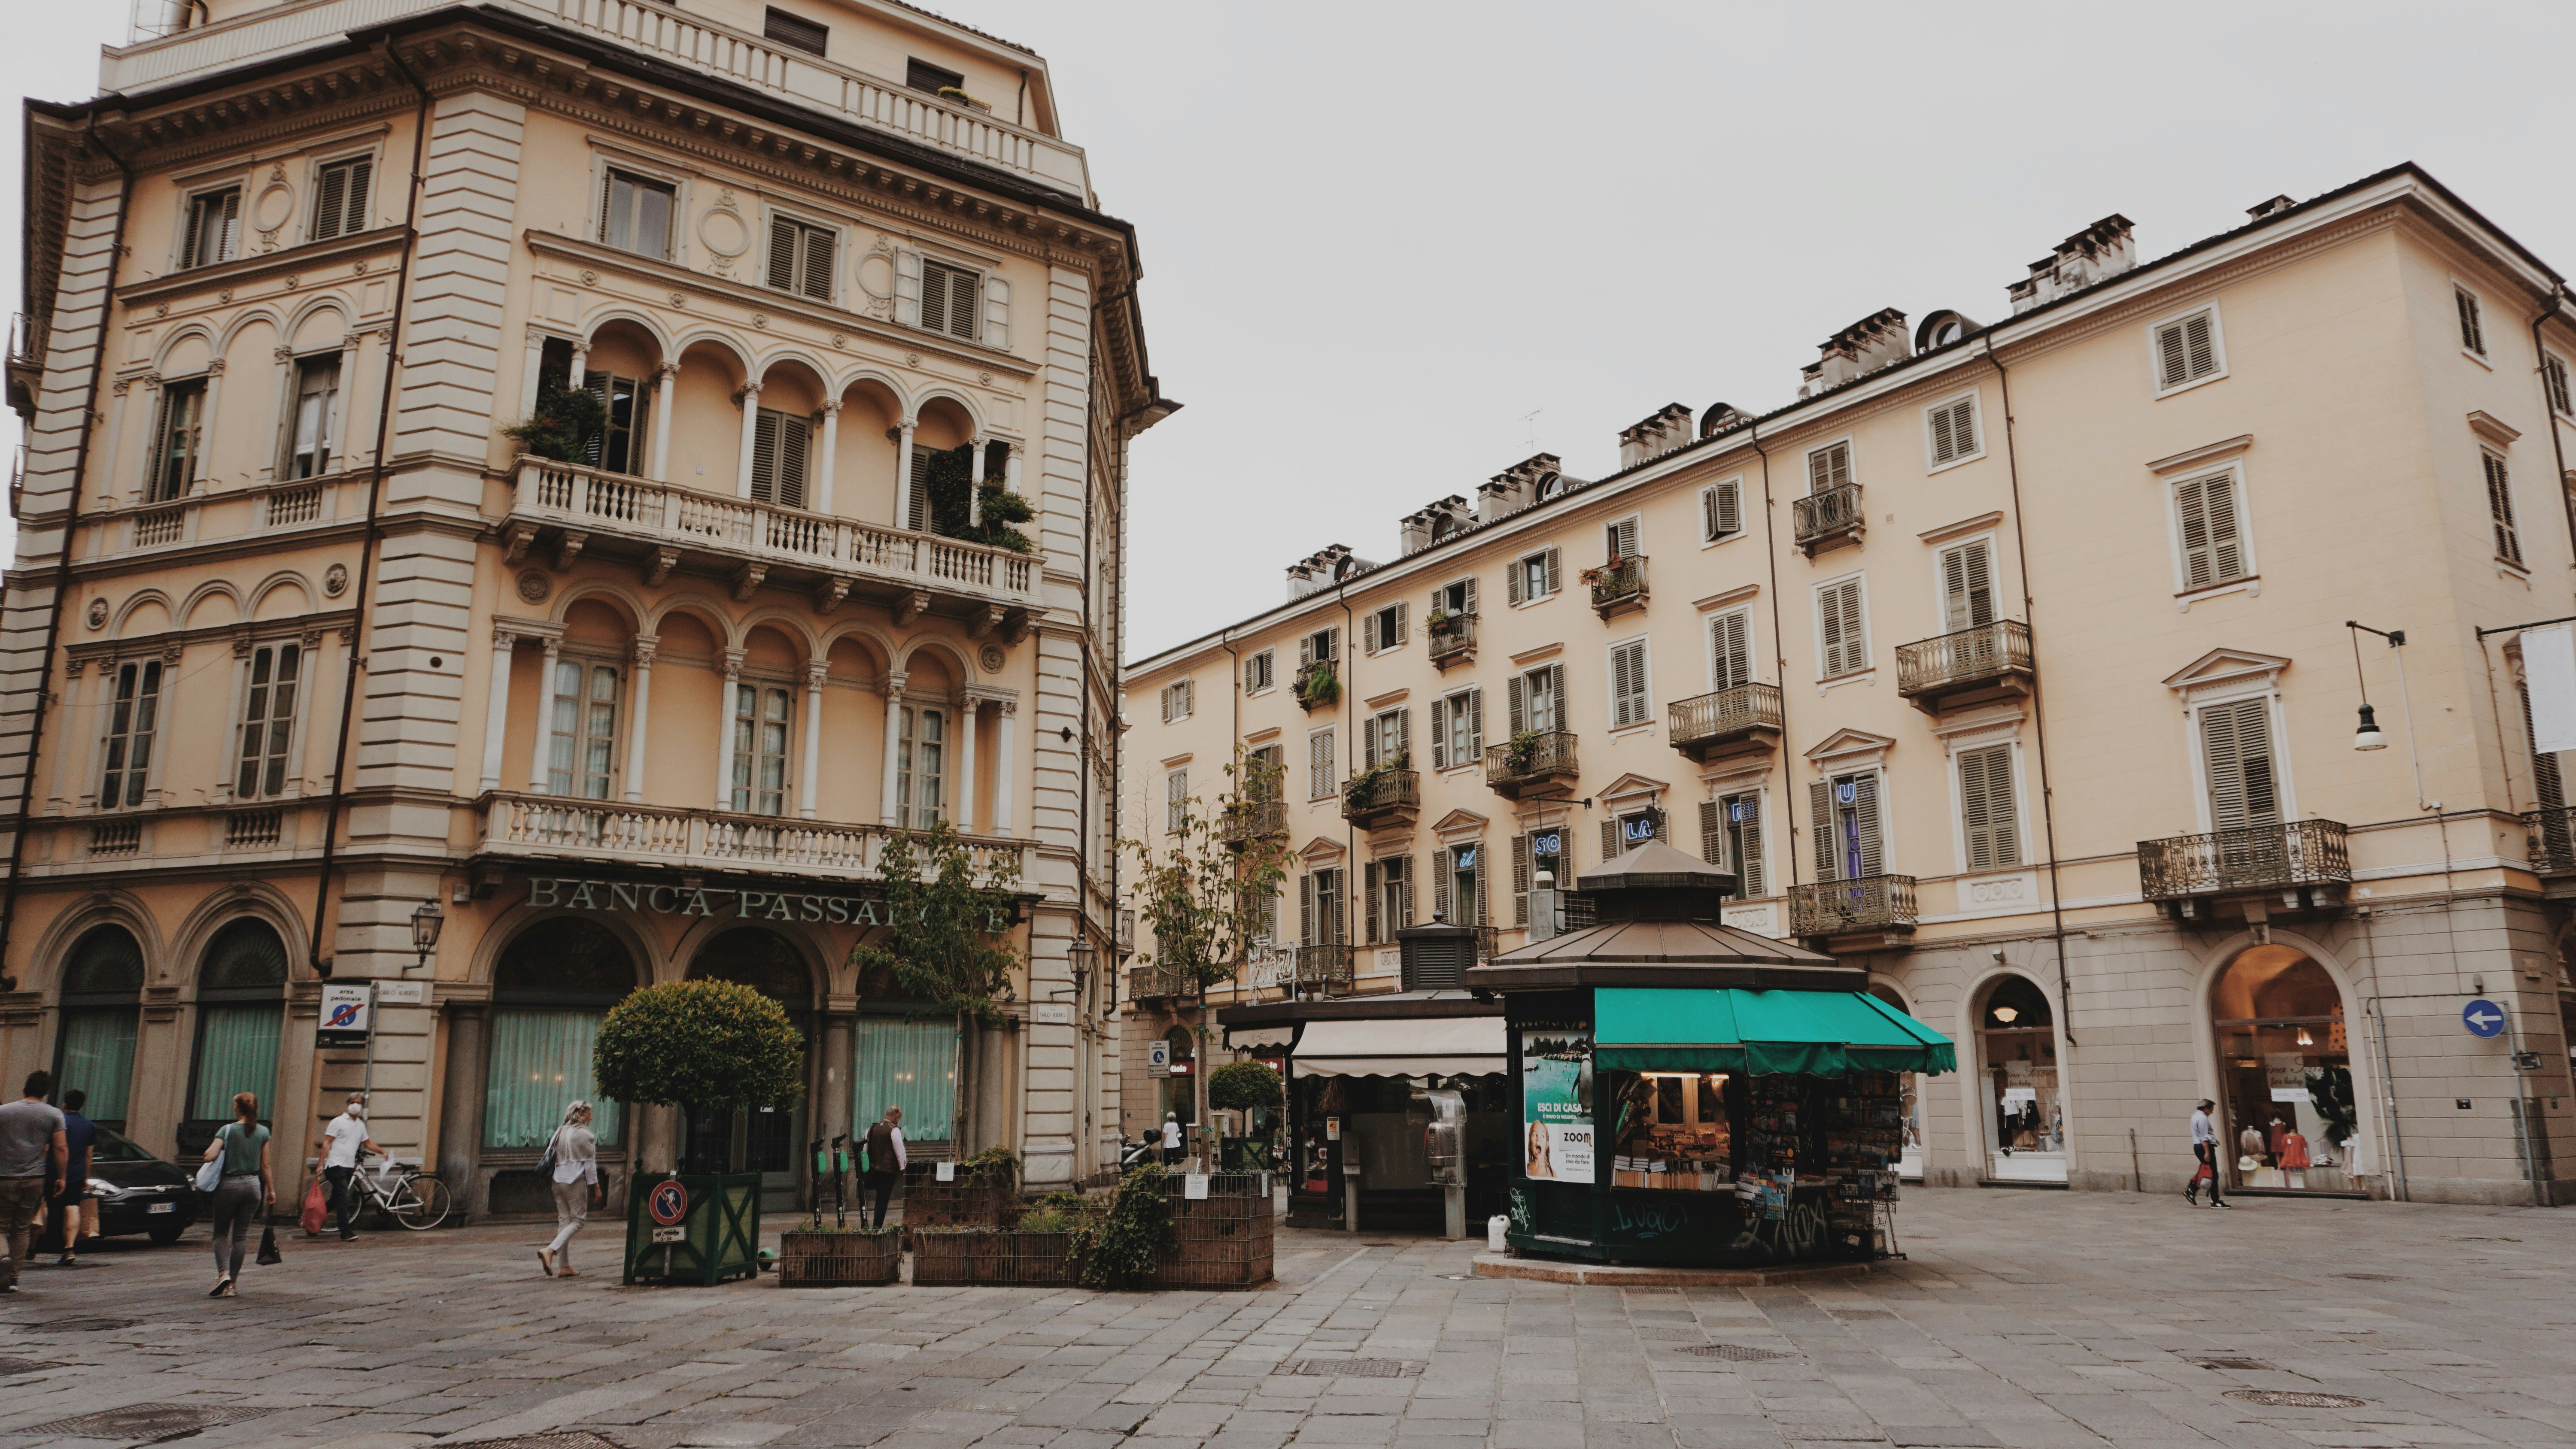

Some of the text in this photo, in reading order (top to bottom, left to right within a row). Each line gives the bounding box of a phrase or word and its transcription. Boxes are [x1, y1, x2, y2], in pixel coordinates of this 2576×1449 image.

[1535, 834, 1560, 854] SO
[1626, 820, 1652, 840] LA
[525, 877, 714, 916] BANCA
[1537, 1103, 1583, 1113] ESCI DI CASA
